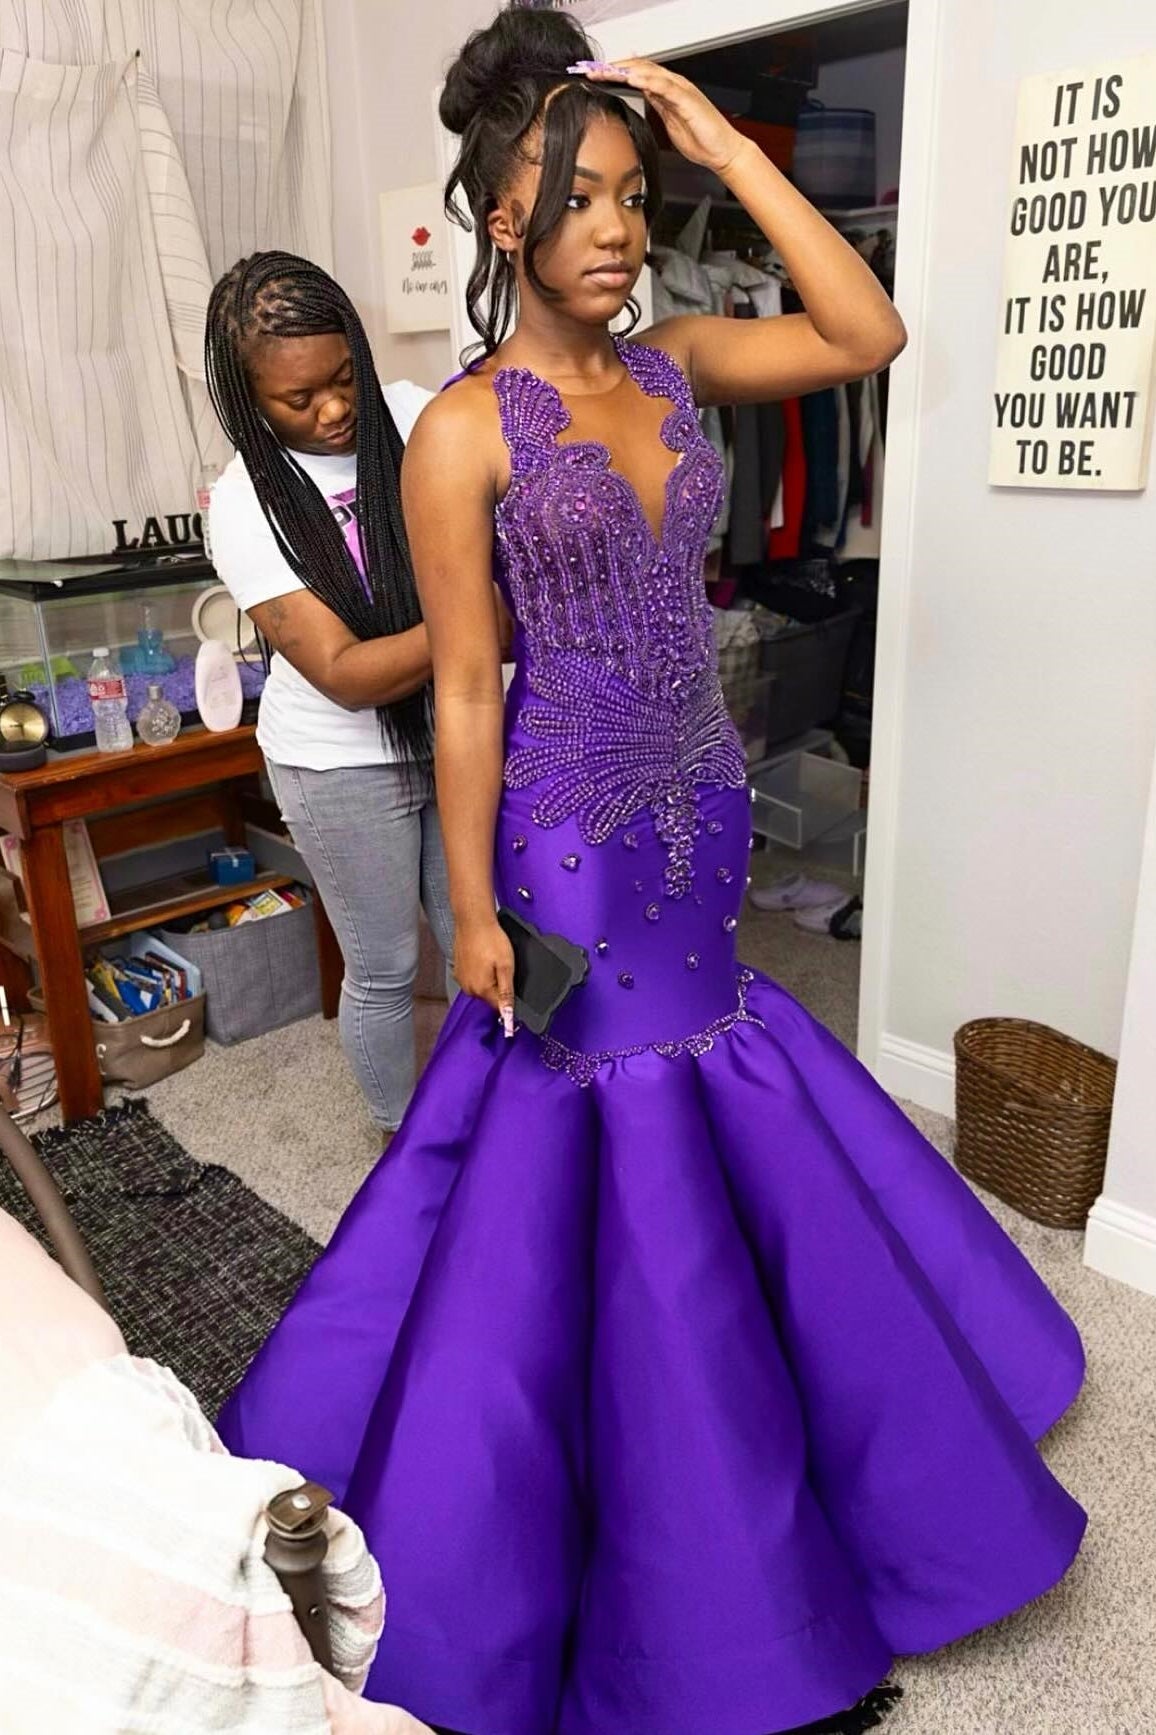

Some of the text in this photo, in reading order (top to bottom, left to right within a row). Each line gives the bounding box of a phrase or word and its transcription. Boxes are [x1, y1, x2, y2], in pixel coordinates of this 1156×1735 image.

[1053, 74, 1123, 127] IT IS
[1019, 125, 1156, 185] NOT HOW
[1010, 180, 1156, 236] GOOD YOU
[1042, 240, 1109, 284] ARE,
[1004, 288, 1146, 334] IT IS HOW
[1030, 342, 1106, 381] GOOD
[994, 391, 1139, 428] YOU WANT
[1016, 439, 1102, 476] TO BE.
